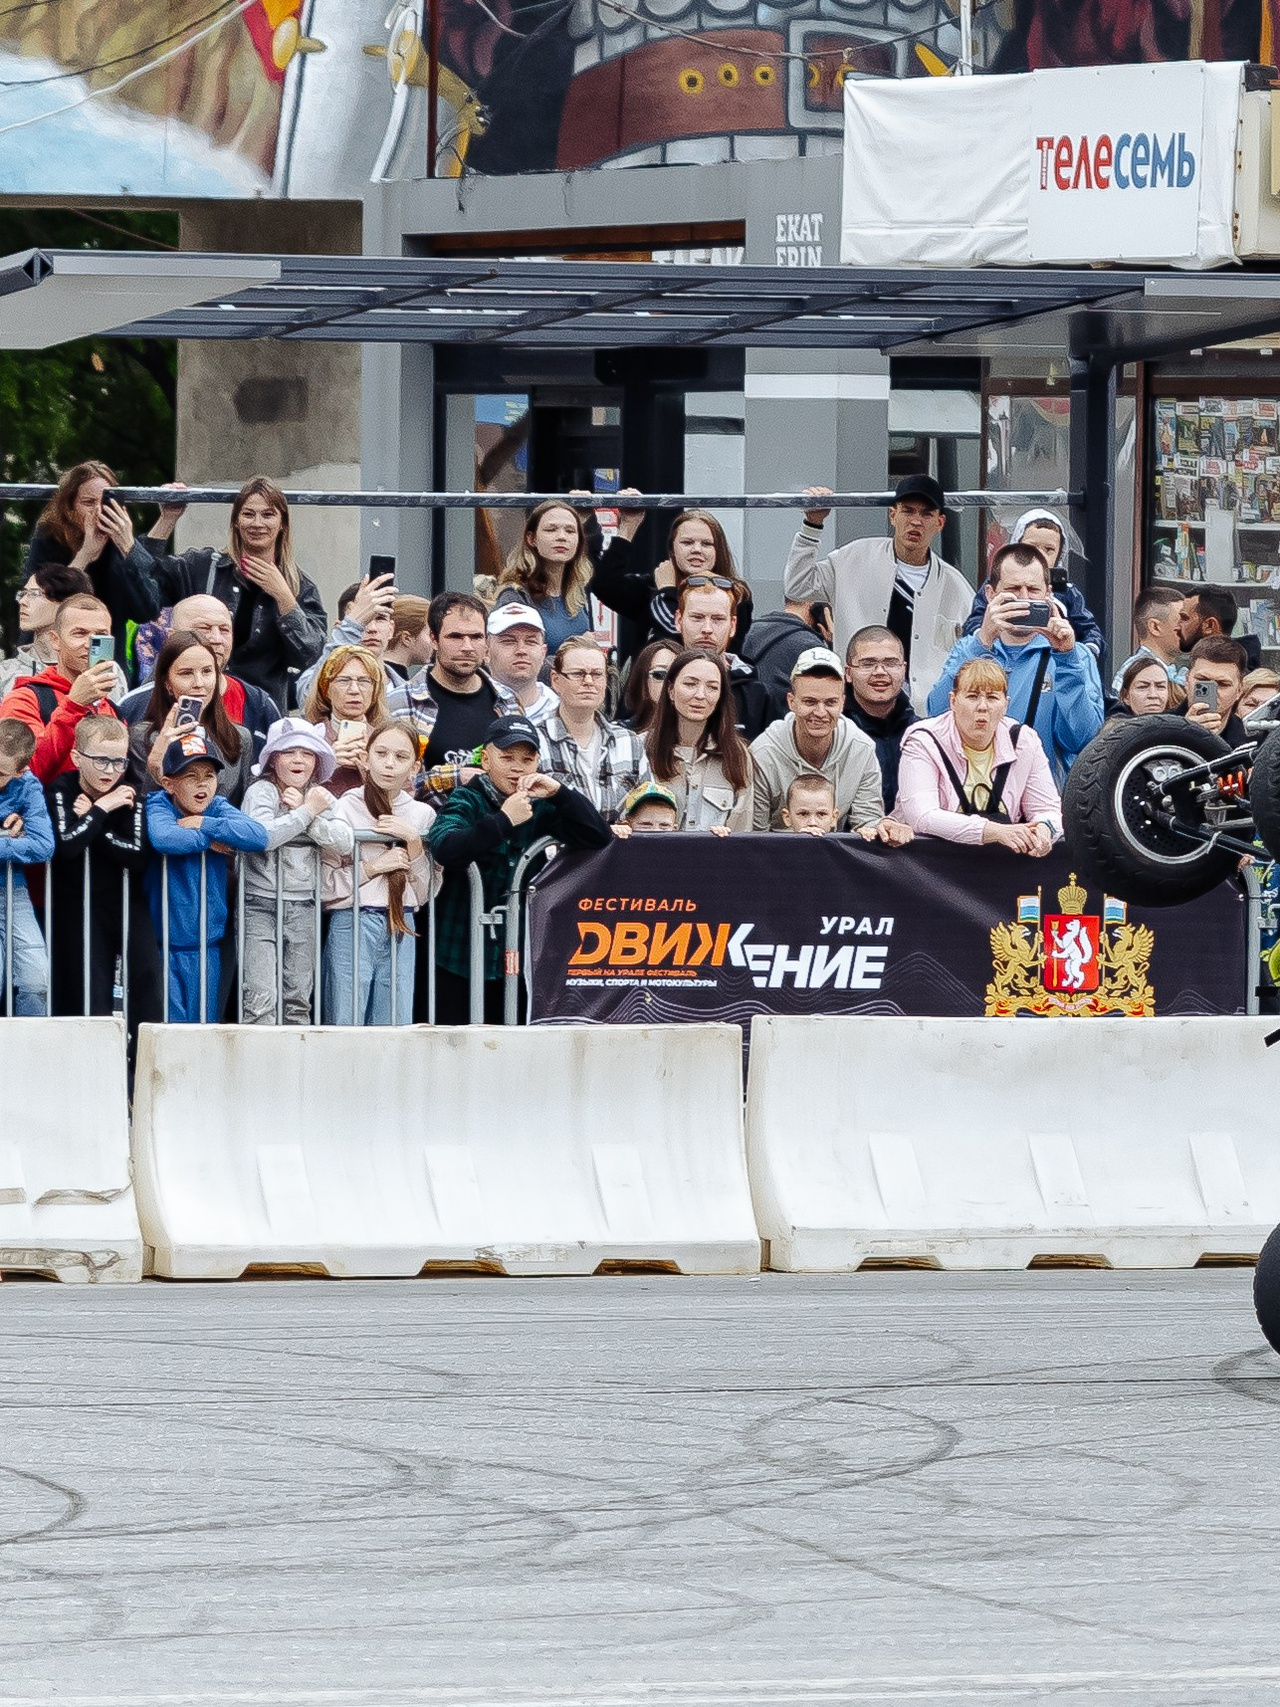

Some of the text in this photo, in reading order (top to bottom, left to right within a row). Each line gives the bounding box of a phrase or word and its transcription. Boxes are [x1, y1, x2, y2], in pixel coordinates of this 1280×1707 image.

[775, 212, 823, 243] EKAT
[577, 897, 698, 912] ФЕСТИВАЛЬ
[819, 916, 895, 937] УРАЛ
[617, 969, 645, 977] УРАЛЕ
[646, 969, 698, 977] ФЕСТИВАЛЬ
[605, 979, 640, 987] СПОРТА
